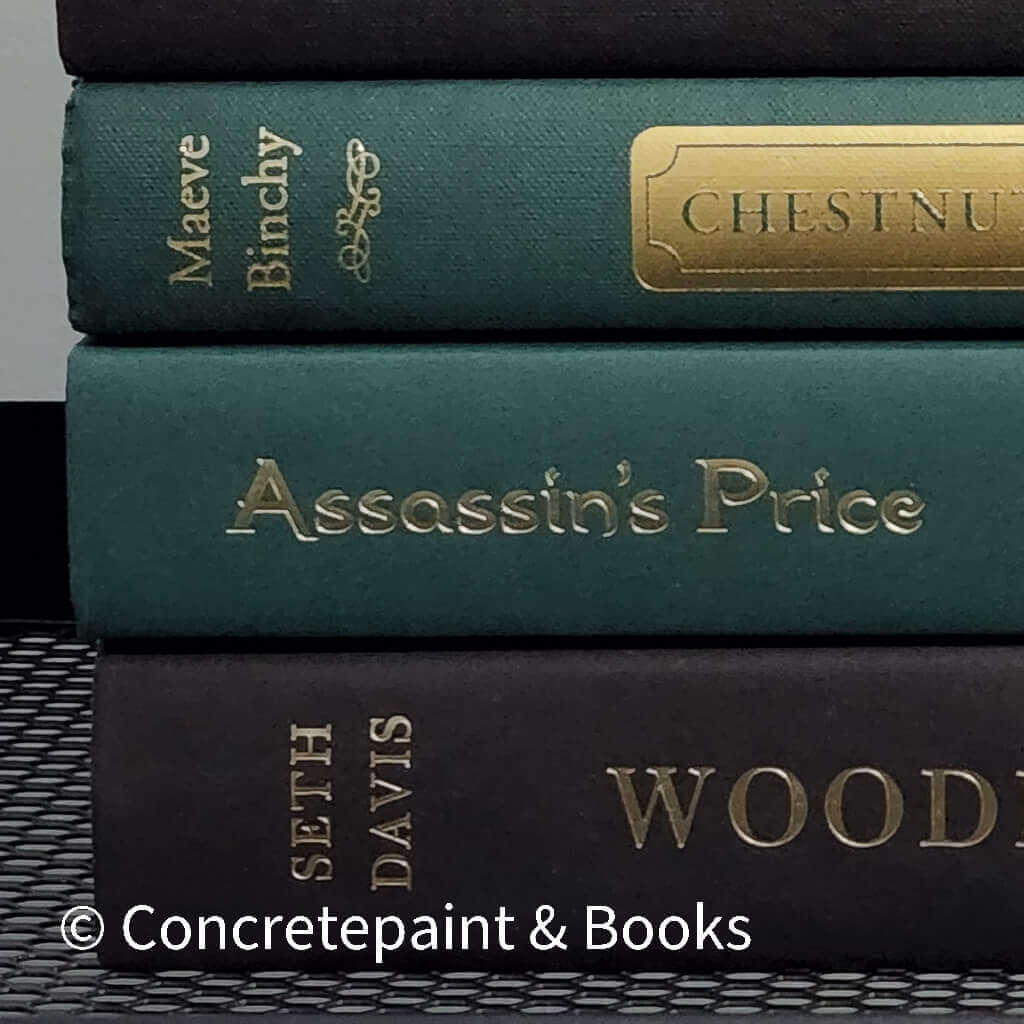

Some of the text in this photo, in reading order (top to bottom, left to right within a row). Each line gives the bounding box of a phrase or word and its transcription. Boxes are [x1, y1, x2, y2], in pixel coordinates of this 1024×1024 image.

[166, 134, 213, 287] Maeve
[241, 126, 303, 292] Binchy
[695, 459, 926, 535] Price
[290, 722, 333, 883] SETH
[368, 713, 414, 893] DAVIS
